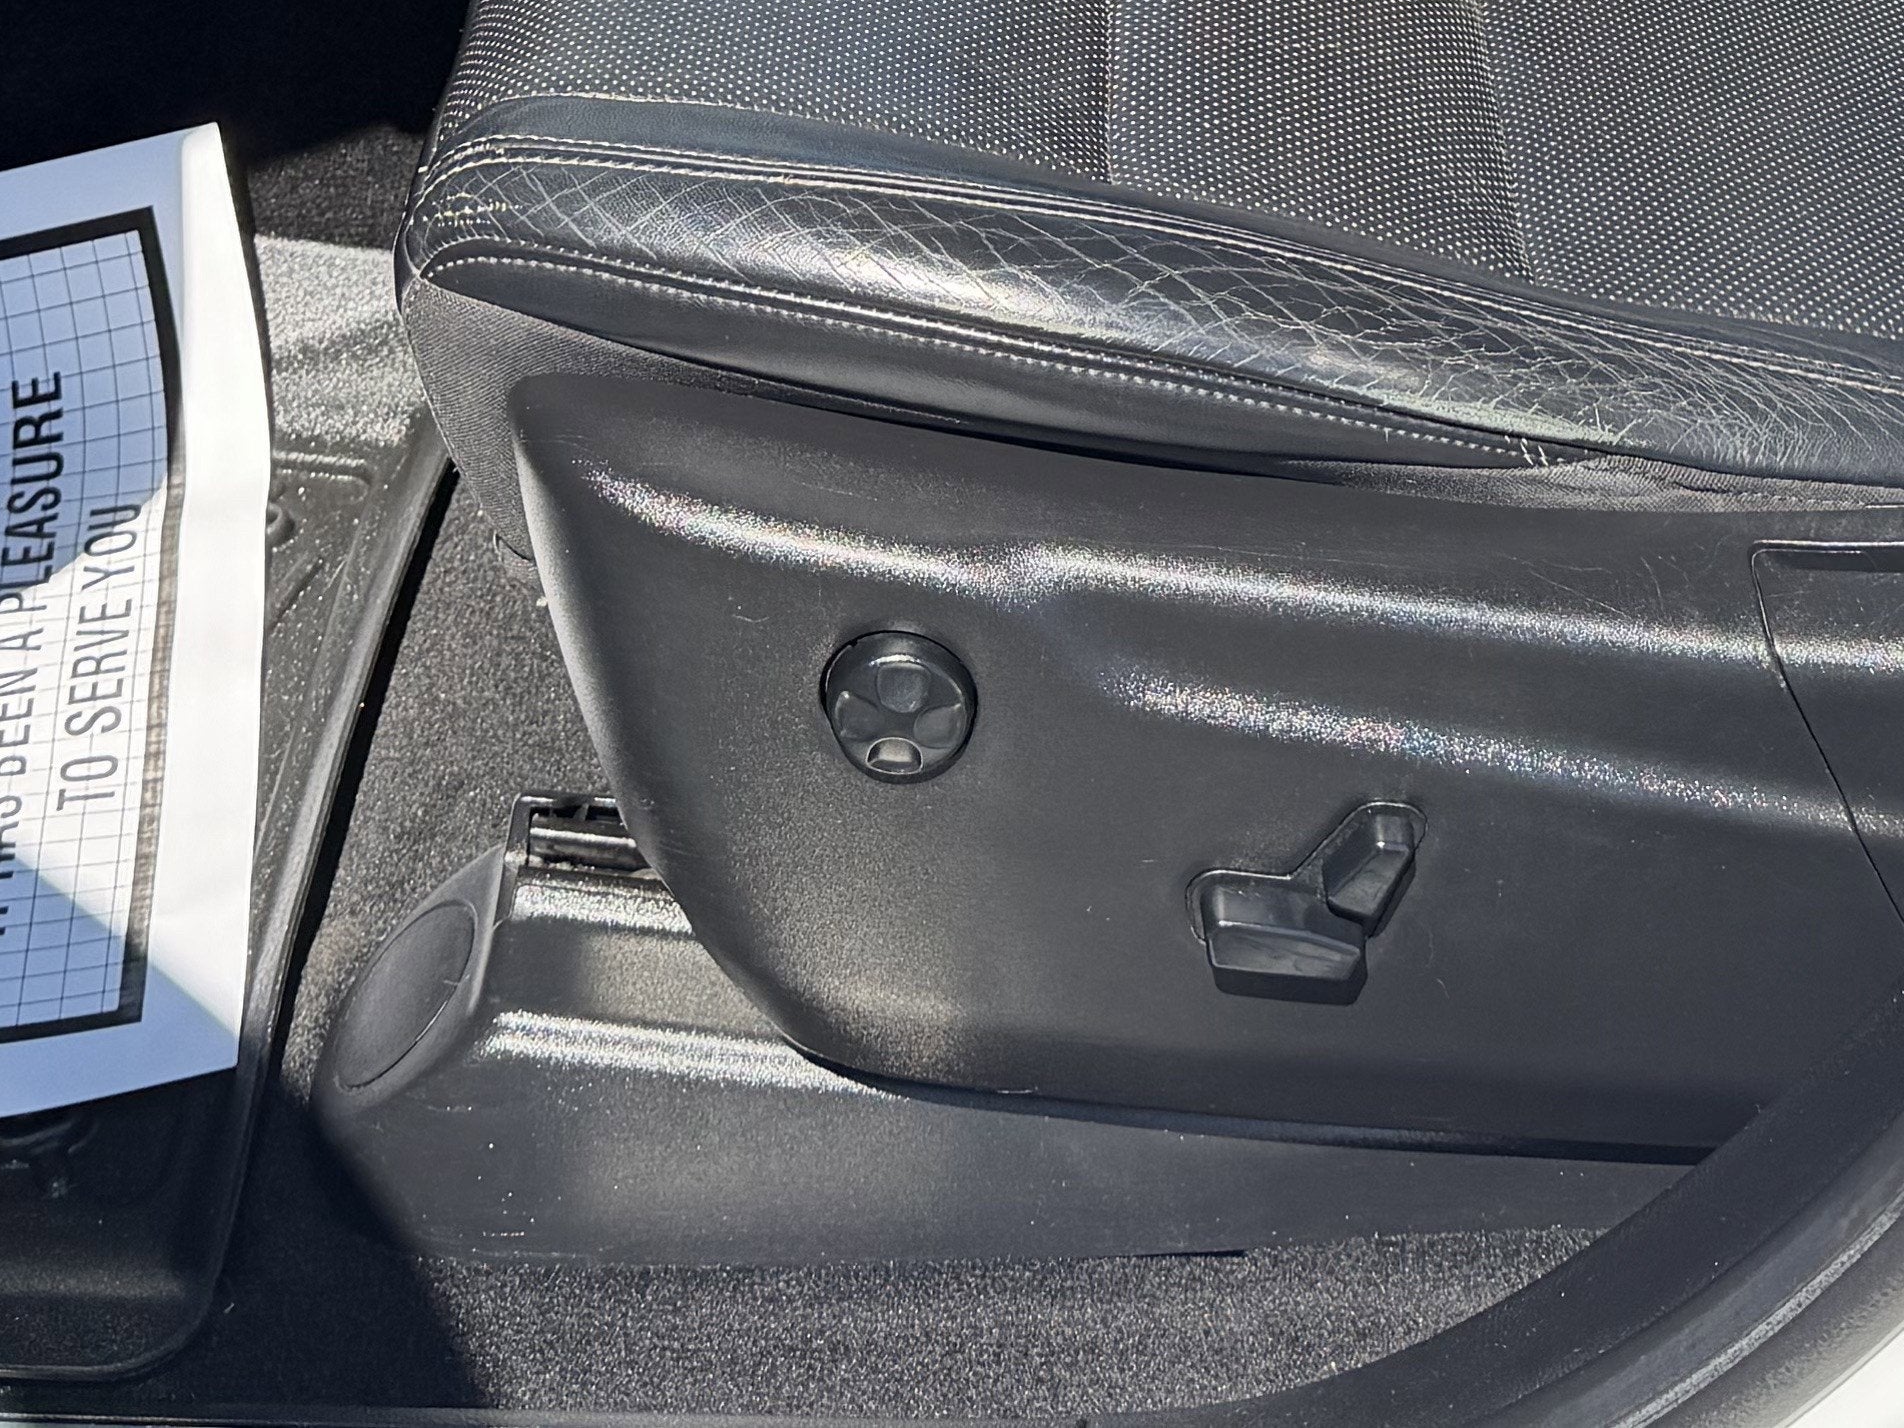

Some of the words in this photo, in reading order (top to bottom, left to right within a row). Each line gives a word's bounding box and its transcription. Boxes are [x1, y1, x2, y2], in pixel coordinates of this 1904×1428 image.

[80, 502, 142, 593] YOU
[64, 597, 133, 736] SERVE
[56, 753, 119, 811] TO
